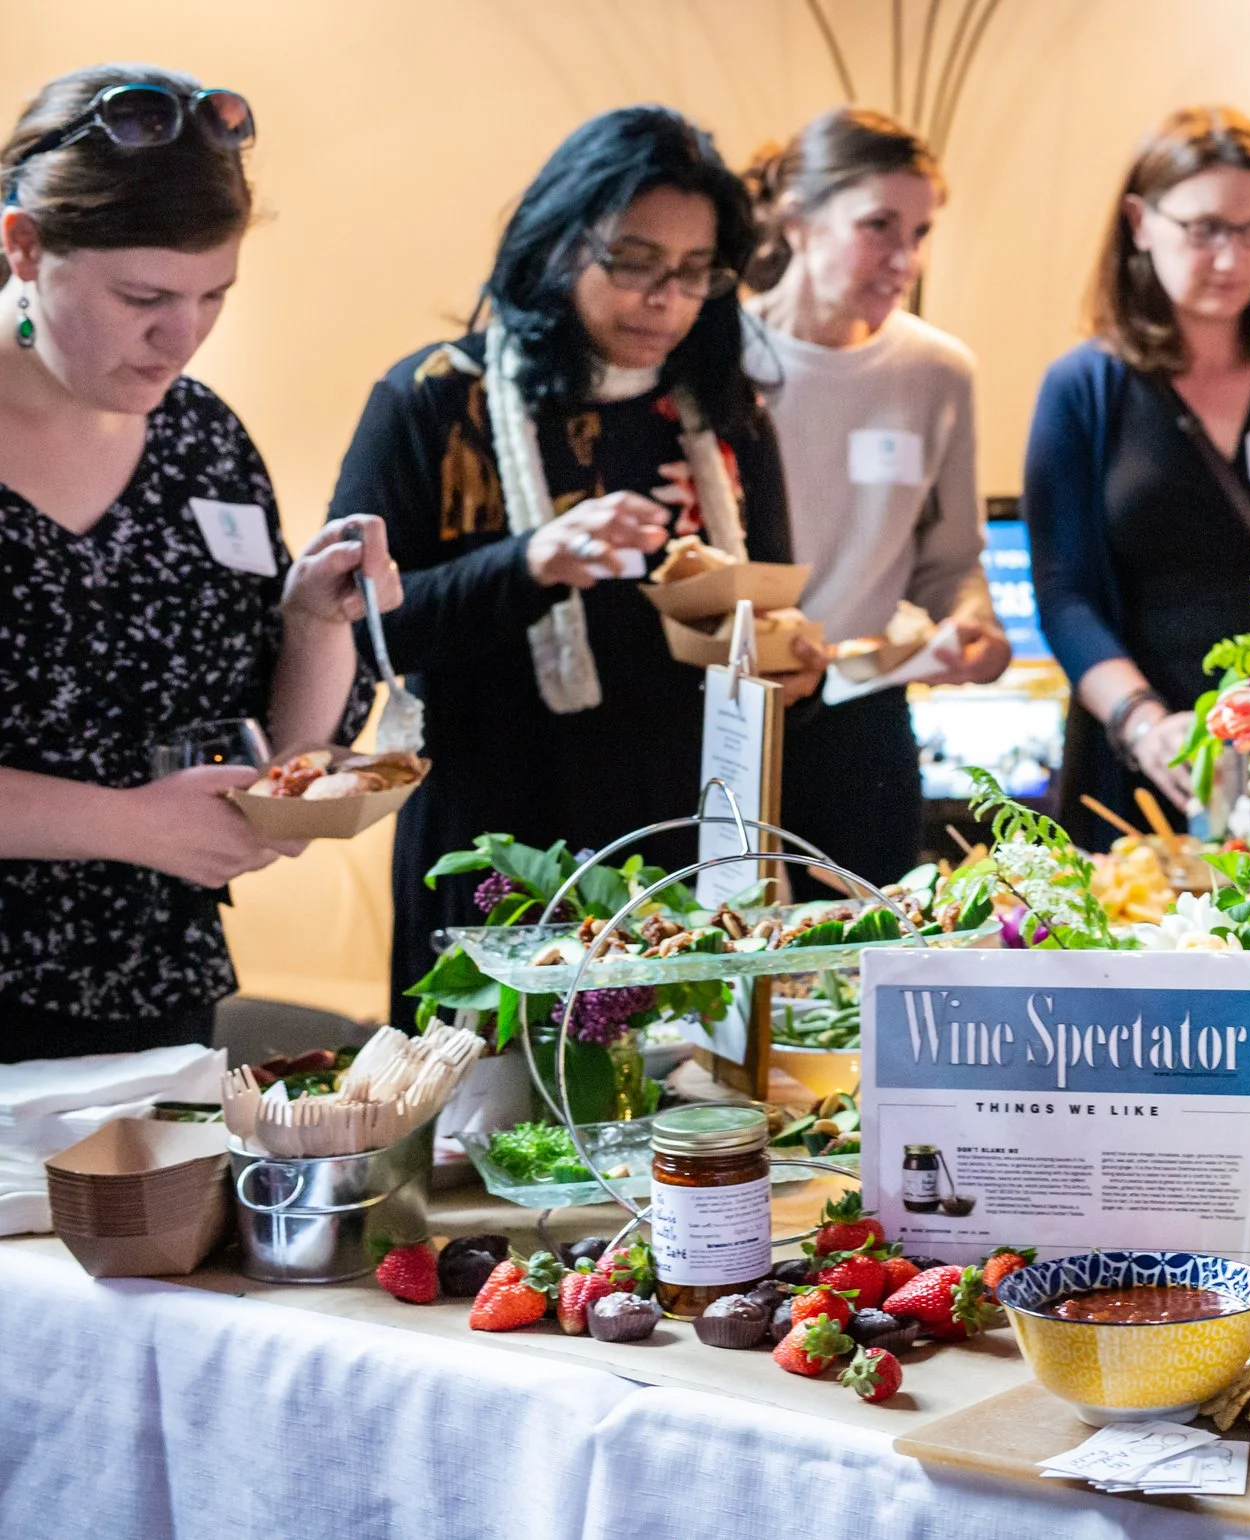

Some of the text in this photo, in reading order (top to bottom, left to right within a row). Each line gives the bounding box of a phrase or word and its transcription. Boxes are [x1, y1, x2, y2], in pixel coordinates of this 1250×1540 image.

[904, 990, 1248, 1089] Wine Spectator
[976, 1102, 1159, 1116] THINGS WE LIKE
